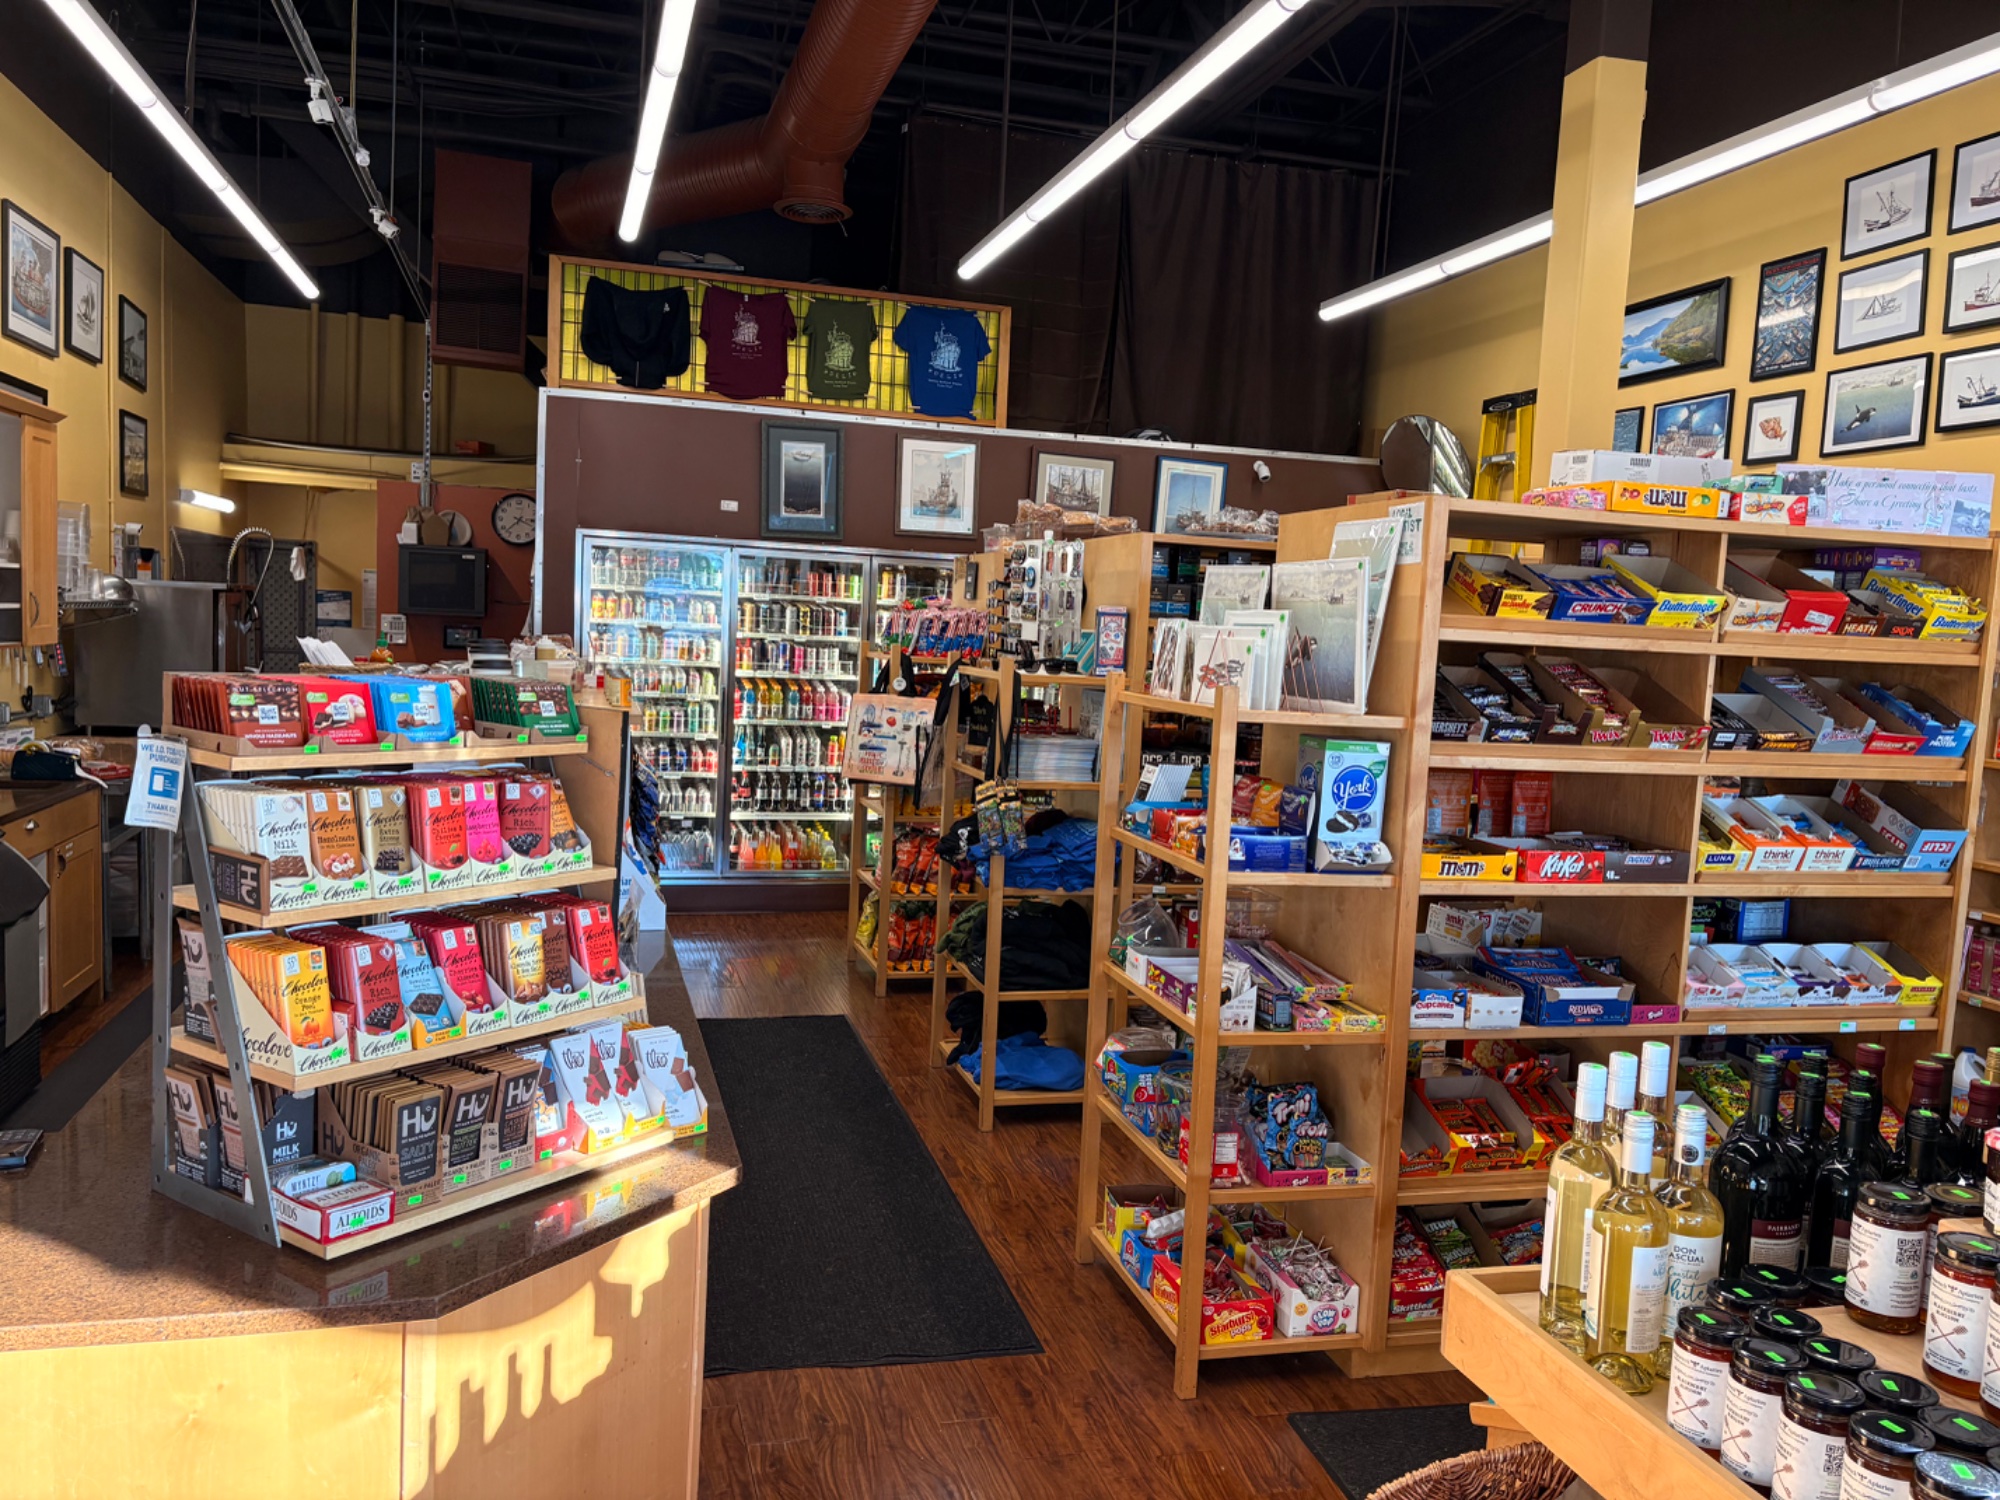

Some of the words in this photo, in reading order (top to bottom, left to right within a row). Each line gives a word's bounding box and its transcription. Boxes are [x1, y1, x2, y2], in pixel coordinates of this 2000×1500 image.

[1828, 469, 1851, 488] Make
[1881, 494, 1922, 511] Greeting
[1866, 580, 1924, 618] Butterfinger
[1571, 602, 1623, 614] CRUNCH
[1658, 599, 1717, 613] Butterfinger
[1843, 622, 1879, 634] HEATH
[1931, 614, 1984, 630] Butterfinger
[1590, 728, 1622, 742] Twix
[1650, 728, 1687, 742] Twix
[1928, 739, 1957, 749] PROTEIN
[1333, 776, 1374, 808] York
[147, 801, 168, 813] THANK
[273, 840, 298, 850] Milk
[1708, 854, 1733, 863] LUNA
[1763, 849, 1794, 860] think!
[1815, 849, 1845, 860] think!
[242, 1027, 292, 1058] hocolove
[273, 1143, 299, 1157] MILK
[401, 1140, 435, 1161] SALTY
[1673, 1245, 1697, 1256] DON
[1668, 1253, 1705, 1263] ASCUAL
[1668, 1266, 1700, 1281] Coastal
[1392, 1301, 1433, 1314] Skittles
[1313, 1309, 1337, 1322] BLOW
[1209, 1311, 1255, 1337] Starburst
[1317, 1317, 1333, 1329] POP
